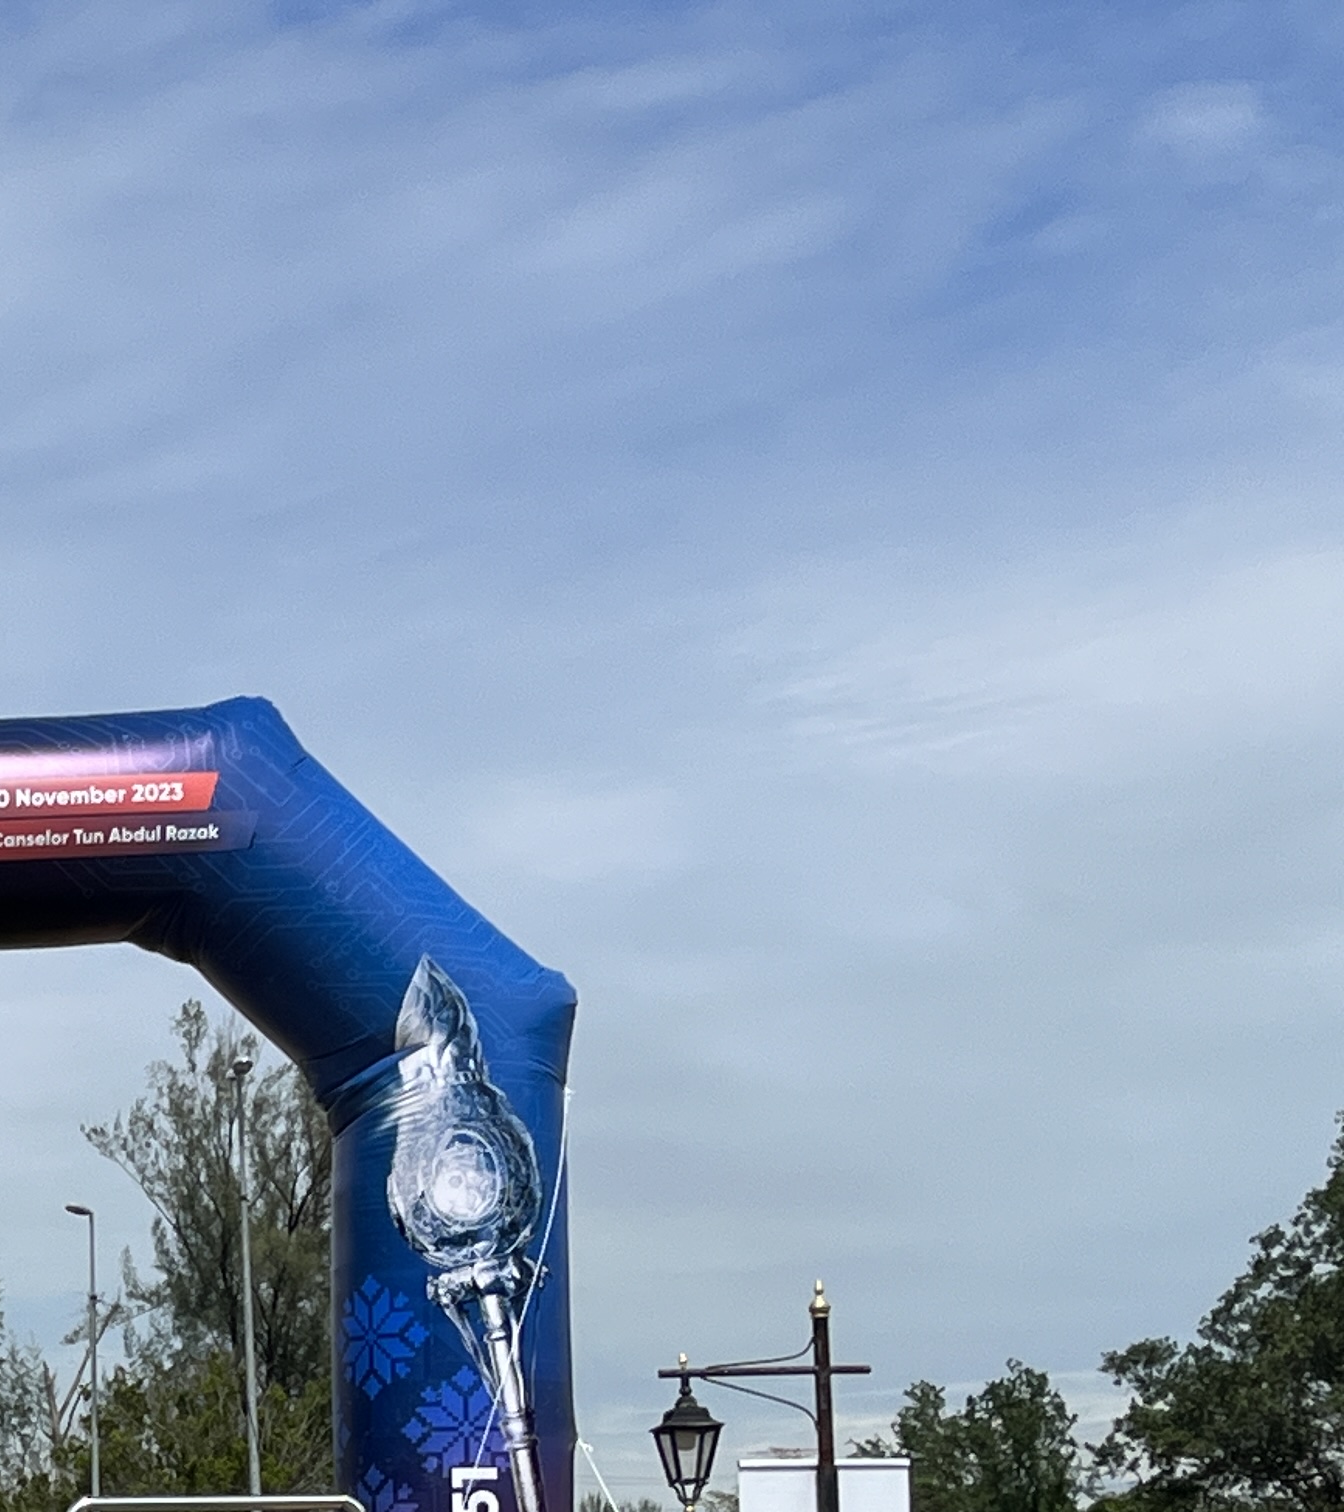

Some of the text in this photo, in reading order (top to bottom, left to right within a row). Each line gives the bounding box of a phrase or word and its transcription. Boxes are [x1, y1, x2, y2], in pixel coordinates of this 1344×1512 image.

[15, 785, 127, 808] November
[130, 782, 185, 803] 2023
[73, 828, 105, 845] Tun
[107, 824, 161, 844] Abdul
[165, 823, 219, 841] Razak
